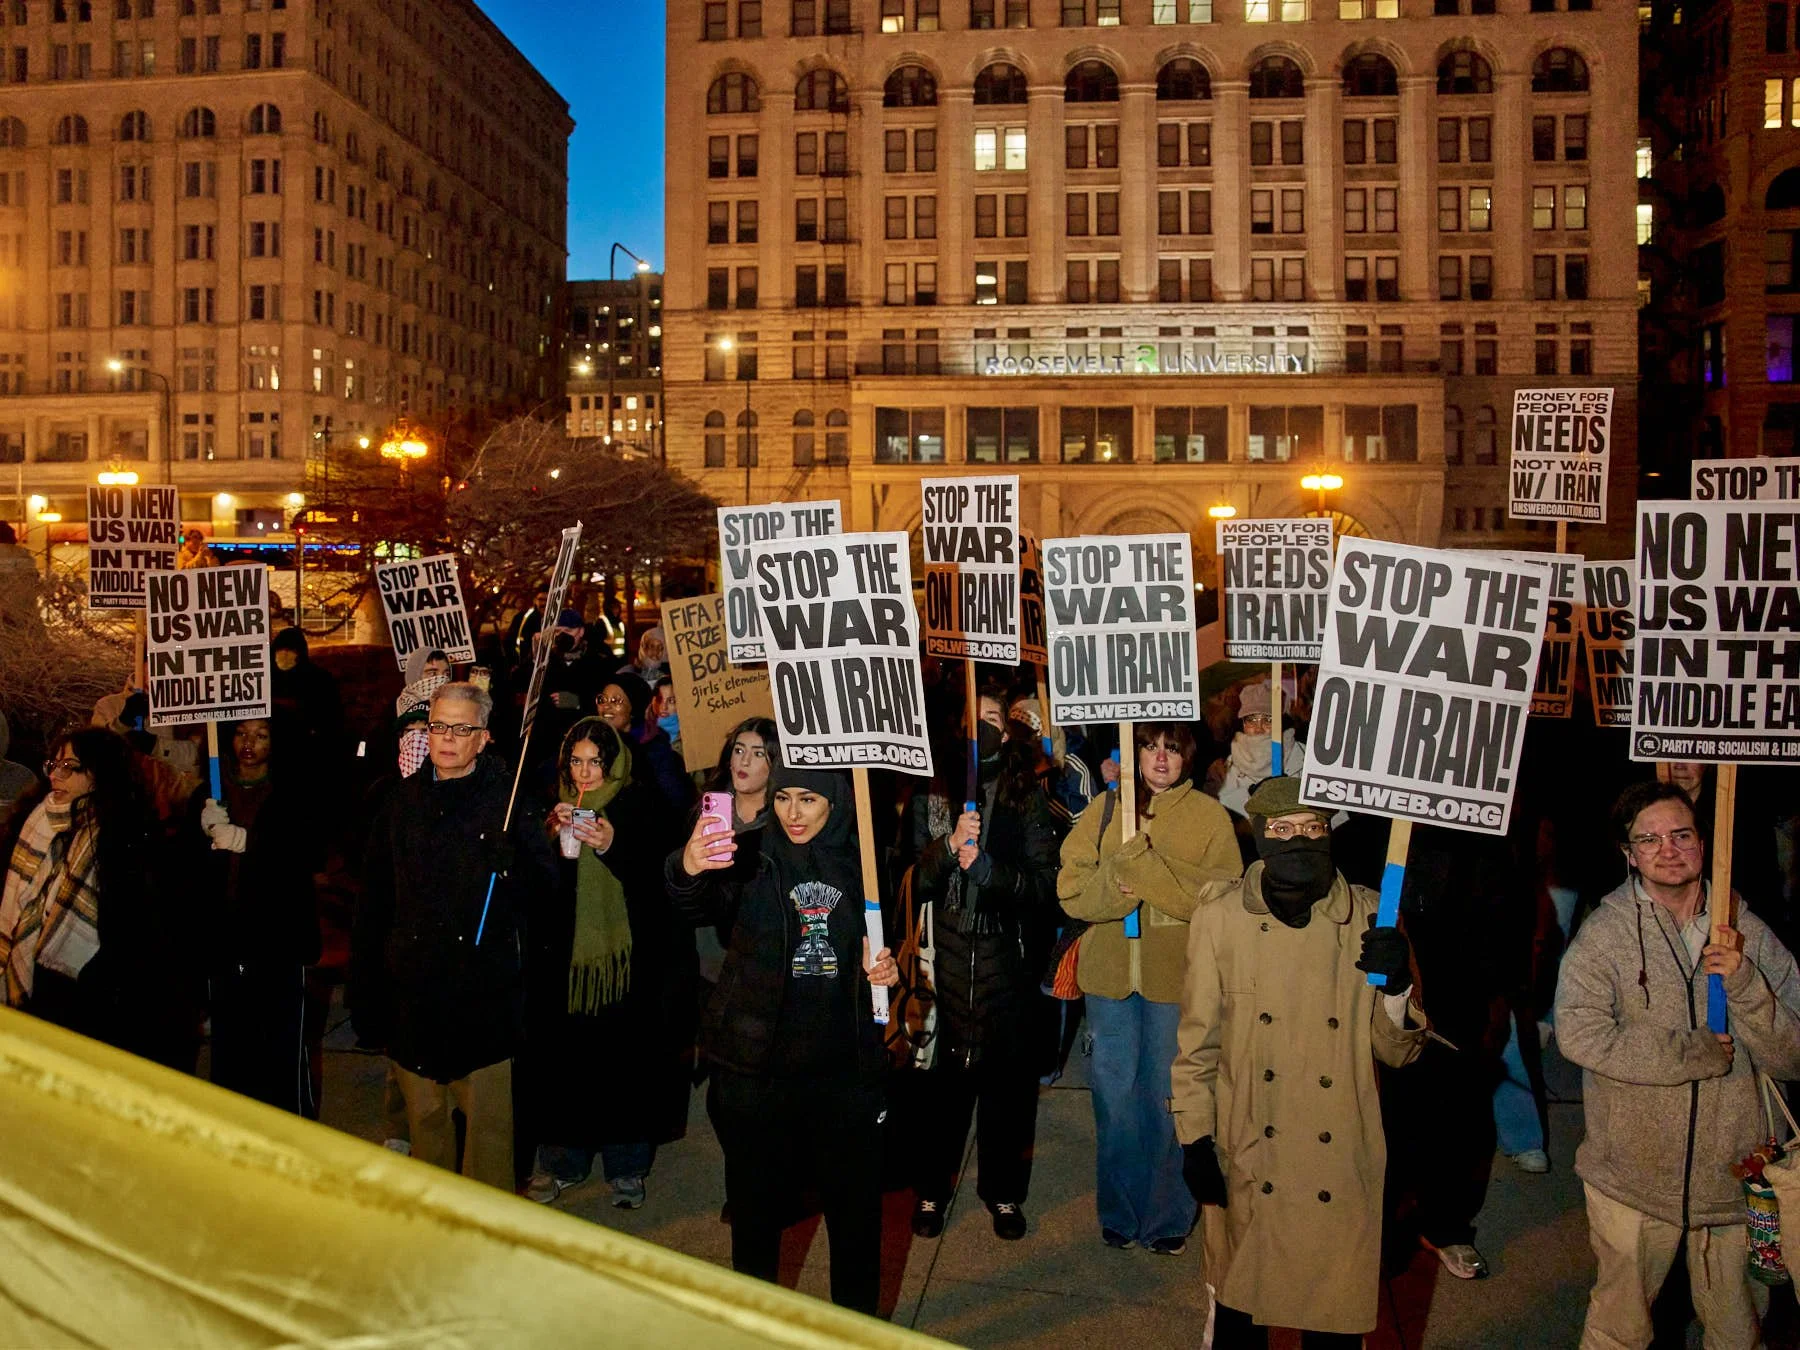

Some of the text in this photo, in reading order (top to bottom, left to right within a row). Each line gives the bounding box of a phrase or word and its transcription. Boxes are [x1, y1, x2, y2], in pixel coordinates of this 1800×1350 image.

[985, 355, 1125, 374] ROOSEVELT
[1165, 353, 1305, 373] UNIVERSITY
[1516, 403, 1607, 414] PEOPLE'S
[1517, 393, 1608, 401] MONEY FOR
[1515, 415, 1605, 454] NEEDS
[1513, 460, 1602, 472] NOT WAR
[1696, 466, 1767, 500] STOP
[89, 488, 175, 520] NO NEW
[924, 484, 1012, 523] STOP THE
[1513, 472, 1601, 503] W/ IRAN
[724, 508, 835, 546] STOP THE
[1513, 502, 1599, 518] ANSWERCOALITION.ORG
[90, 520, 176, 544] US WAR
[925, 526, 1014, 564] WAR
[1223, 523, 1329, 533] MONEY FOR
[1223, 535, 1329, 546] PEOPLE'S
[91, 549, 175, 570] IN THE
[1047, 545, 1121, 585] STOP
[1128, 543, 1184, 582] THE
[1640, 512, 1708, 581] NO
[1724, 513, 1800, 581] NE
[91, 570, 145, 592] MIDDLE
[378, 559, 454, 592] STOP THE
[756, 548, 839, 602] STOP
[846, 543, 901, 594] THE
[1224, 548, 1329, 589] NEEDS
[149, 568, 263, 613] NO NEW
[384, 584, 459, 614] WAR
[926, 571, 953, 631] ON
[958, 572, 1016, 635] IRAN!
[1338, 550, 1452, 618] STOP
[1463, 567, 1541, 634] THE
[1583, 566, 1630, 608] NO
[669, 602, 711, 631] FIFA
[1048, 585, 1187, 625] WAR
[1225, 593, 1327, 642] IRAN!
[1639, 584, 1800, 632] US WA
[151, 608, 264, 643] US WAR
[391, 610, 469, 656] ON IRAN!
[674, 625, 721, 655] PRIZE
[763, 598, 910, 650] WAR
[1586, 610, 1635, 641] US
[149, 644, 264, 677] IN THE
[929, 639, 1017, 660] PSLWEB.ORG
[1053, 631, 1192, 697] ON IRAN!
[1336, 610, 1533, 692] WAR
[1592, 649, 1634, 674] IN
[1641, 637, 1800, 679] IN TH
[150, 672, 264, 708] MIDDLE EAST
[775, 656, 922, 737] ON IRAN!
[1638, 681, 1800, 729] MIDDLE EA
[162, 715, 180, 724] PARTY
[181, 714, 193, 722] FOR
[194, 710, 225, 721] SOCIALISM
[1057, 702, 1193, 720] PSLWEB.ORG
[1313, 676, 1521, 793] ON IRAN!
[1662, 739, 1694, 754] PARTY
[1696, 741, 1716, 755] FOR
[1718, 741, 1770, 756] SOCIALISM
[1771, 742, 1780, 756] &
[790, 744, 927, 768] PSLWEB.ORG
[1307, 779, 1503, 827] PSLWEB.ORG
